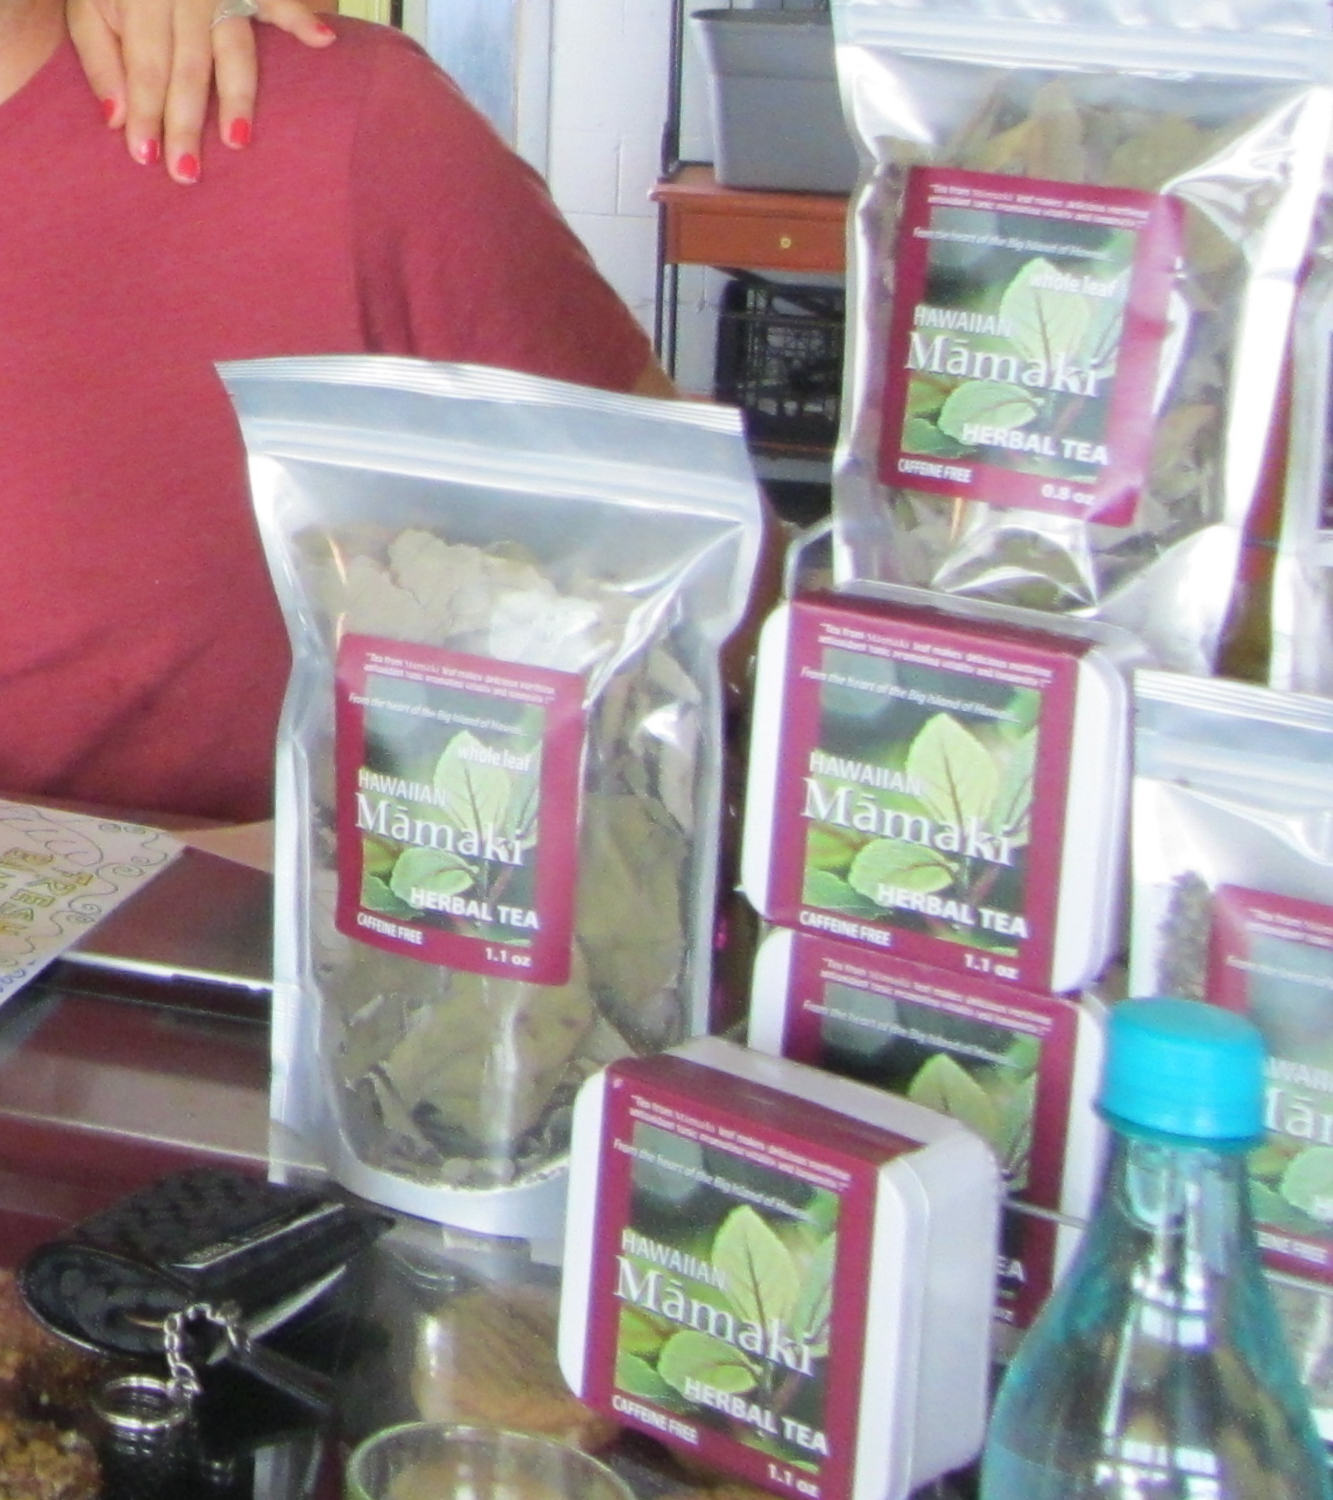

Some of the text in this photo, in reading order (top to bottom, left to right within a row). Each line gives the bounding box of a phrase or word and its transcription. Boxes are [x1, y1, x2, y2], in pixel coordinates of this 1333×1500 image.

[914, 304, 1014, 338] HAWAIIAN
[904, 331, 1098, 397] Māmaki
[963, 423, 1109, 465] HERBAL TEA
[897, 458, 973, 484] CAFFEINE FREE
[1040, 483, 1072, 501] 0.8
[502, 749, 531, 773] leaf
[809, 750, 922, 796] HAWAIIAN
[359, 769, 447, 806] HAWAIIAN
[355, 792, 524, 866] Māmaki
[800, 777, 1014, 867] Māmaki
[357, 912, 423, 945] CAFFEINE FREE
[410, 887, 540, 929] HERBAL TEA
[799, 910, 892, 948] CAFFEINE FREE
[878, 883, 1030, 939] HERBAL TEA
[485, 947, 531, 967] 1.1 oz
[964, 953, 1019, 980] 1.1 oz
[622, 1228, 727, 1291] HAWAIIAN
[613, 1255, 814, 1377] Māmaki
[612, 1394, 698, 1445] CAFFEINE FREE
[684, 1376, 829, 1456] HERBAL TEA
[767, 1463, 820, 1498] 1.1 oz
